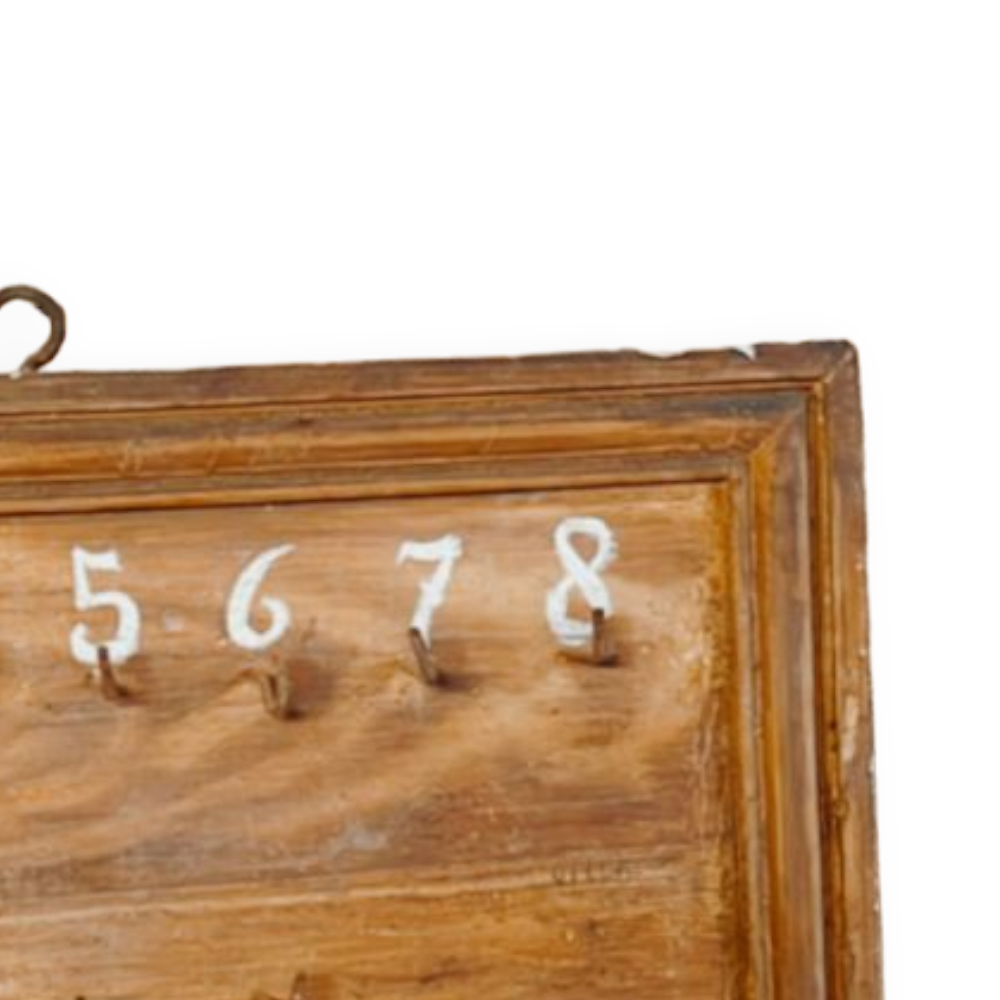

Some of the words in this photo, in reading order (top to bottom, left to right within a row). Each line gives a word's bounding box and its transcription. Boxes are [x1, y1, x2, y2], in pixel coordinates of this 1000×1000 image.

[69, 545, 141, 665] 5
[225, 543, 296, 651] 6
[395, 533, 463, 650] 7
[545, 516, 619, 647] 8
